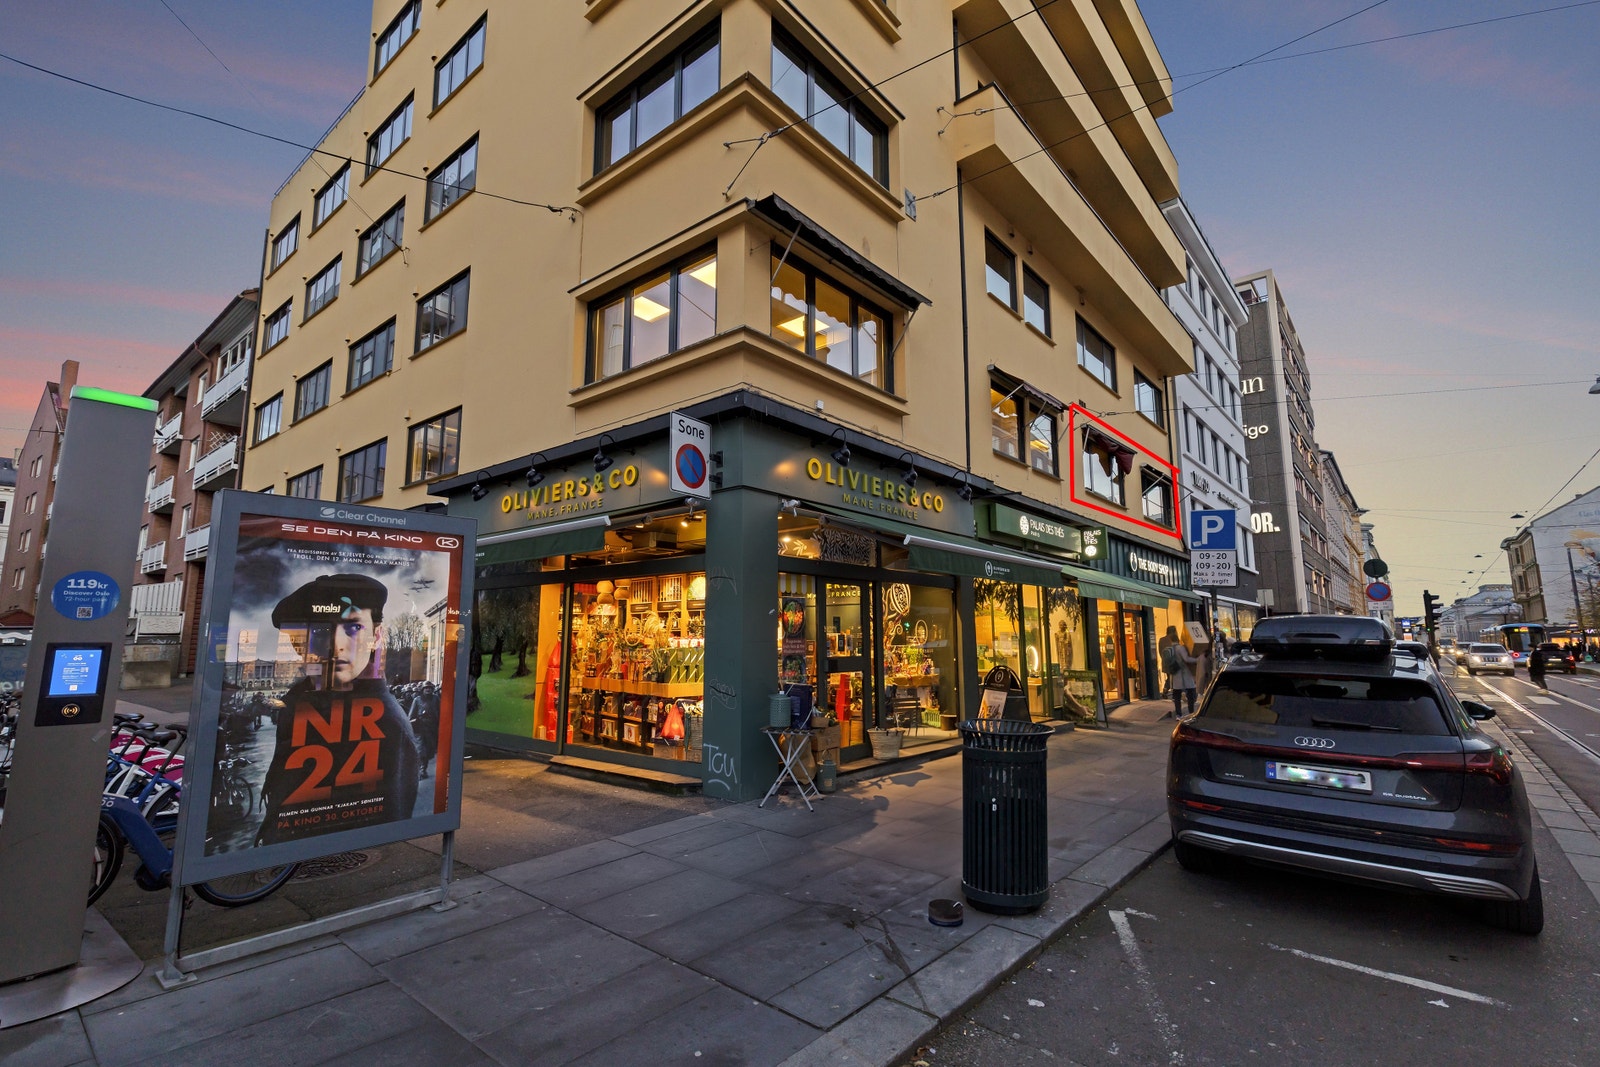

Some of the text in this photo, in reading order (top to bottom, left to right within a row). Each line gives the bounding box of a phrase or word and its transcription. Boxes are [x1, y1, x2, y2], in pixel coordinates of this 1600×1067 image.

[678, 418, 705, 440] Sone
[336, 510, 406, 526] Clear Channel
[1029, 519, 1045, 532] PALAIS
[1045, 524, 1054, 535] DES
[281, 524, 423, 544] SE DEN PÅ KINO
[1202, 515, 1225, 545] P
[338, 550, 366, 558] SKJELVET
[1138, 558, 1169, 576] THE BODY SHOP
[66, 578, 109, 590] 119kr
[290, 698, 386, 748] NR
[280, 740, 384, 807] 24
[278, 809, 298, 818] FILMEN
[310, 804, 334, 813] GUNNAR
[294, 816, 322, 827] KINO
[342, 805, 384, 820] OKTOBER
